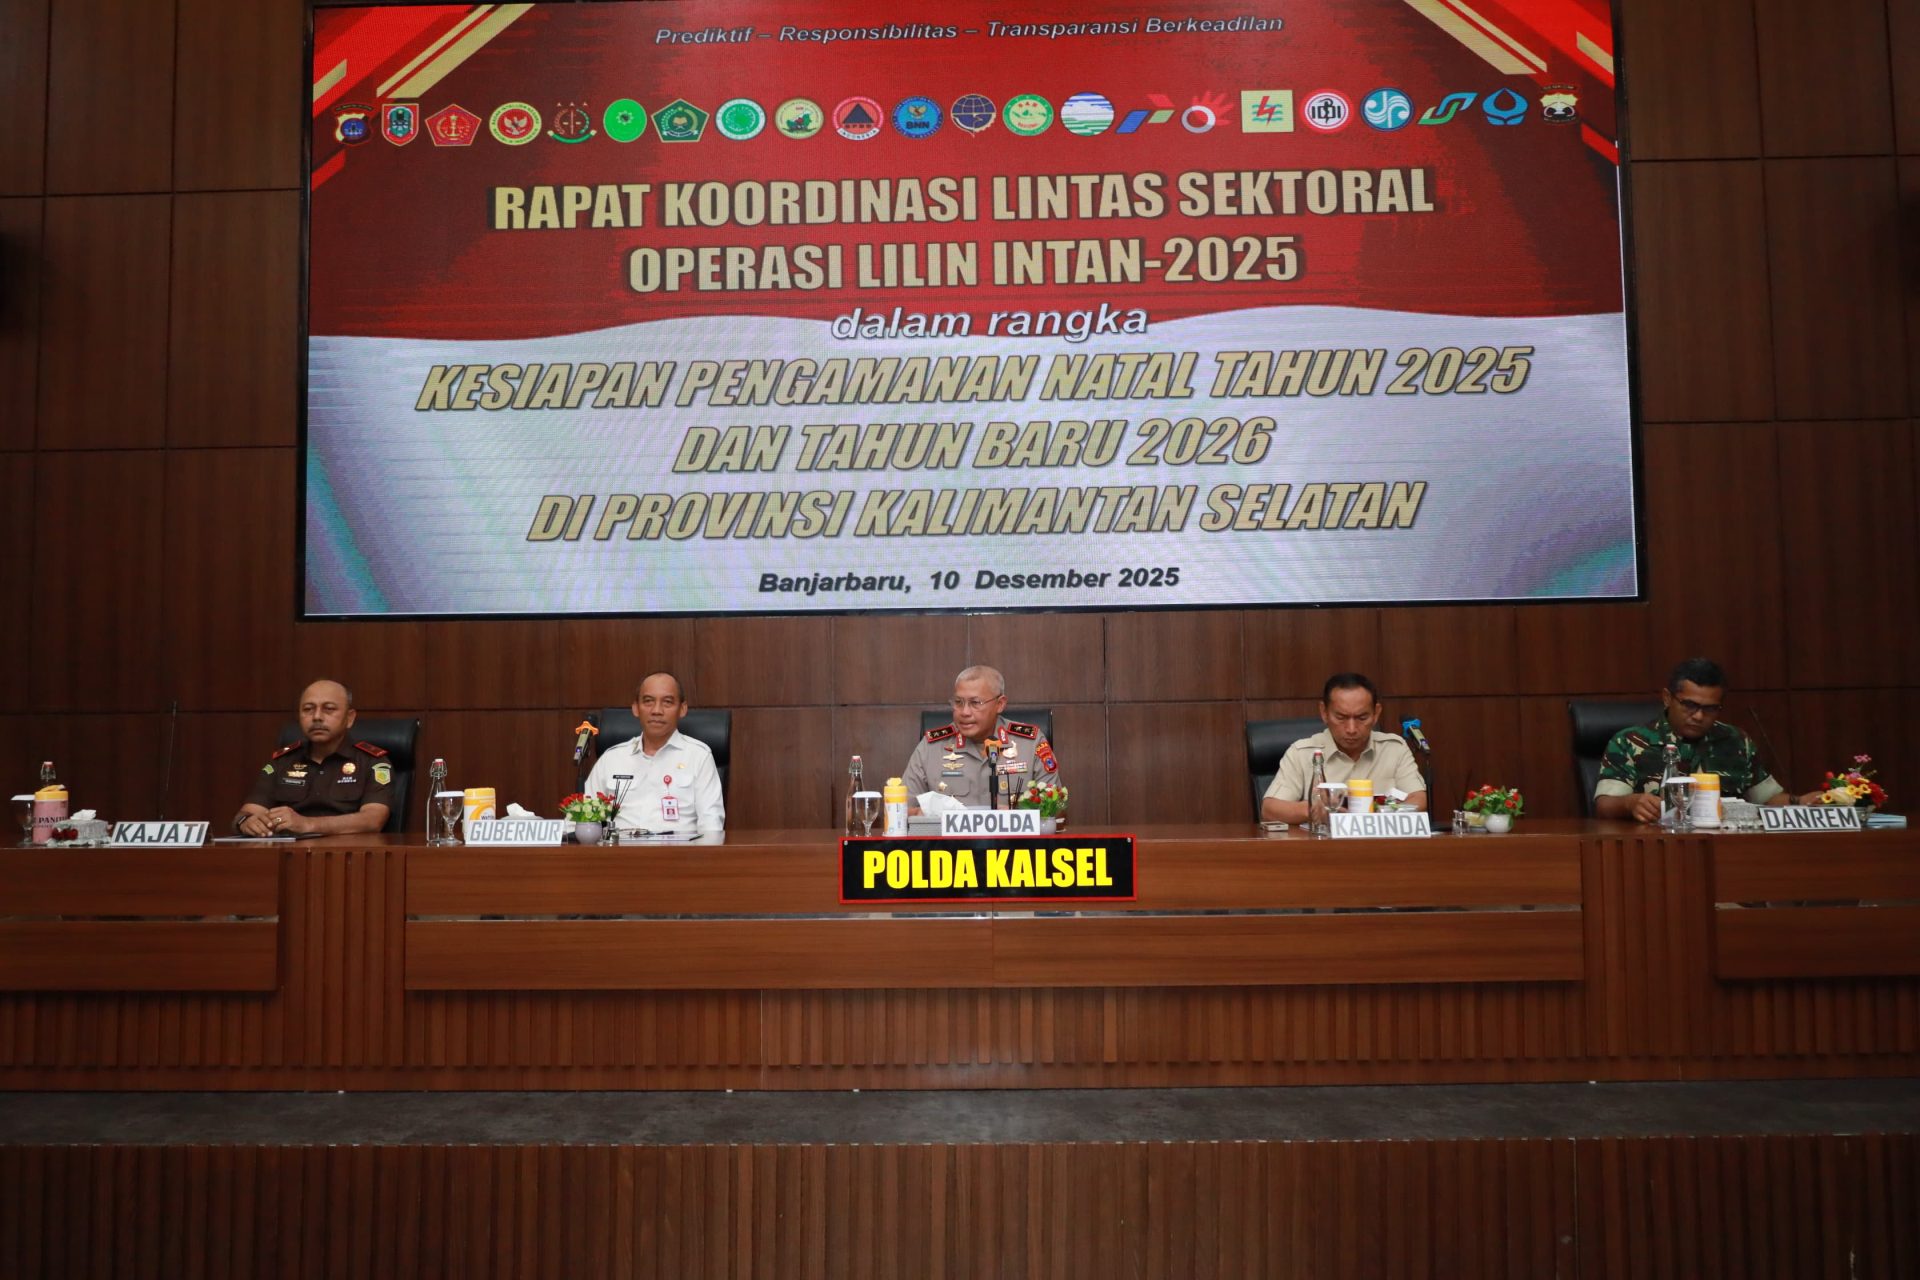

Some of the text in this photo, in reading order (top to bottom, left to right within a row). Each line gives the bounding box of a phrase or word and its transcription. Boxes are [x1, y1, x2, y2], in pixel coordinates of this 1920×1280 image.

[655, 28, 752, 44] Prediktif
[780, 24, 957, 44] Responsibilitas
[988, 18, 1138, 39] Transparansi
[1146, 15, 1283, 33] Berkeadilan
[906, 121, 930, 129] BNN
[493, 167, 1435, 231] RAPAT KOORDINASI LINTAS SEKTORAL
[629, 234, 1299, 294] OPERASI LILIN INTAN-2025
[831, 303, 1148, 343] dalam rangka
[415, 345, 1534, 411] KESIAPAN PENGAMANAN NATAL TAHUN 2025
[672, 416, 1277, 474] DAN TAHUN BARU 2026
[526, 481, 1428, 542] DI PROVINSI KALIMANTAN SELATAN
[758, 566, 1181, 596] Banjarbaru, 10 Desember 2025
[114, 823, 206, 843] KAJATI
[469, 820, 561, 842] GUBERNUR
[945, 813, 1035, 833] KAPOLDA
[1334, 814, 1429, 836] KABINDA
[1764, 807, 1858, 830] DANREM
[863, 848, 1113, 889] POLDA KALSEL
